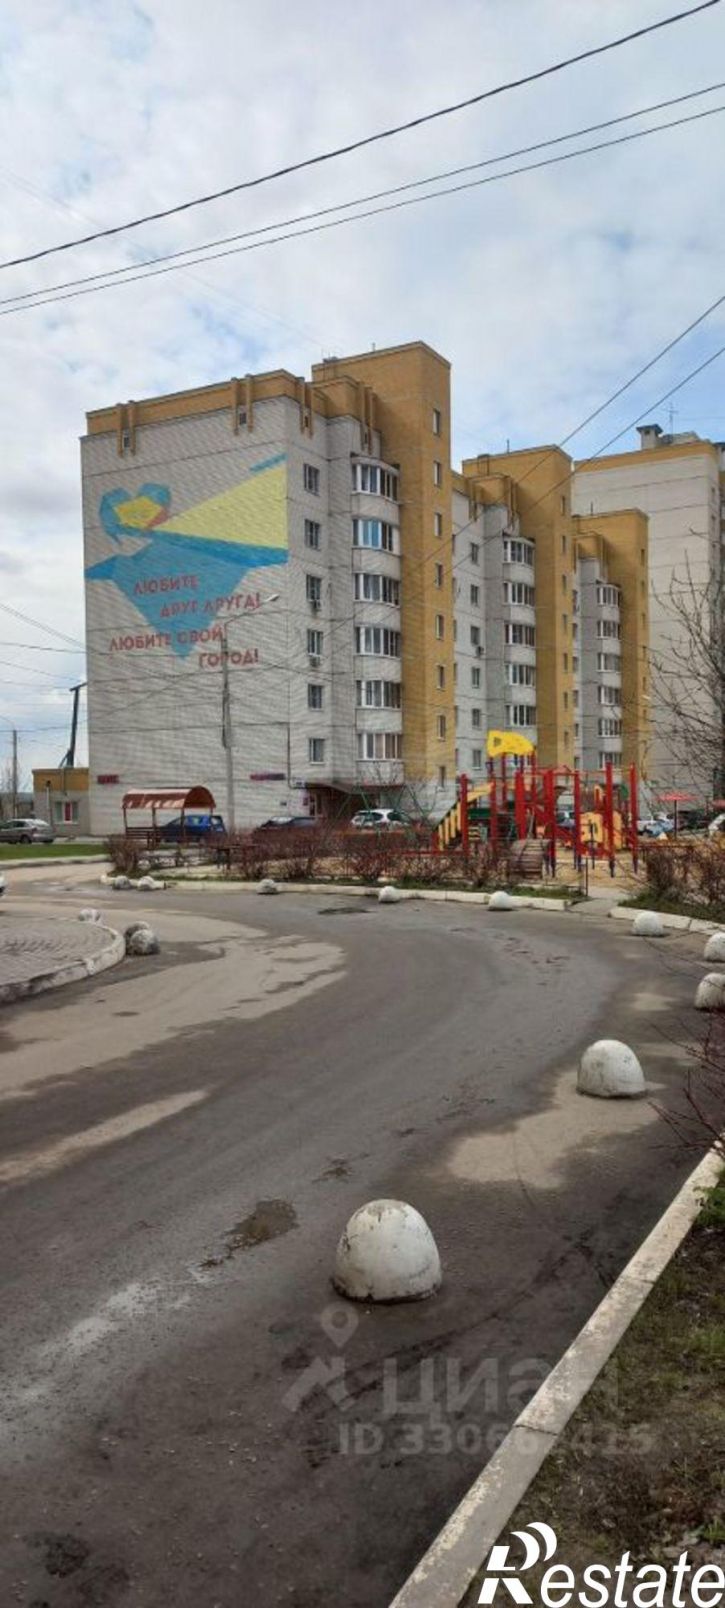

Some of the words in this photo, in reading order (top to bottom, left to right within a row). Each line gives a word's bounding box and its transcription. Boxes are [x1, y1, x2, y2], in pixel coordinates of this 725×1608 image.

[135, 575, 199, 595] ЛЮБИТЕ
[160, 600, 198, 617] ДРУГ
[109, 631, 172, 652] ЛЮБИТЕ
[177, 625, 223, 644] СВОЙ
